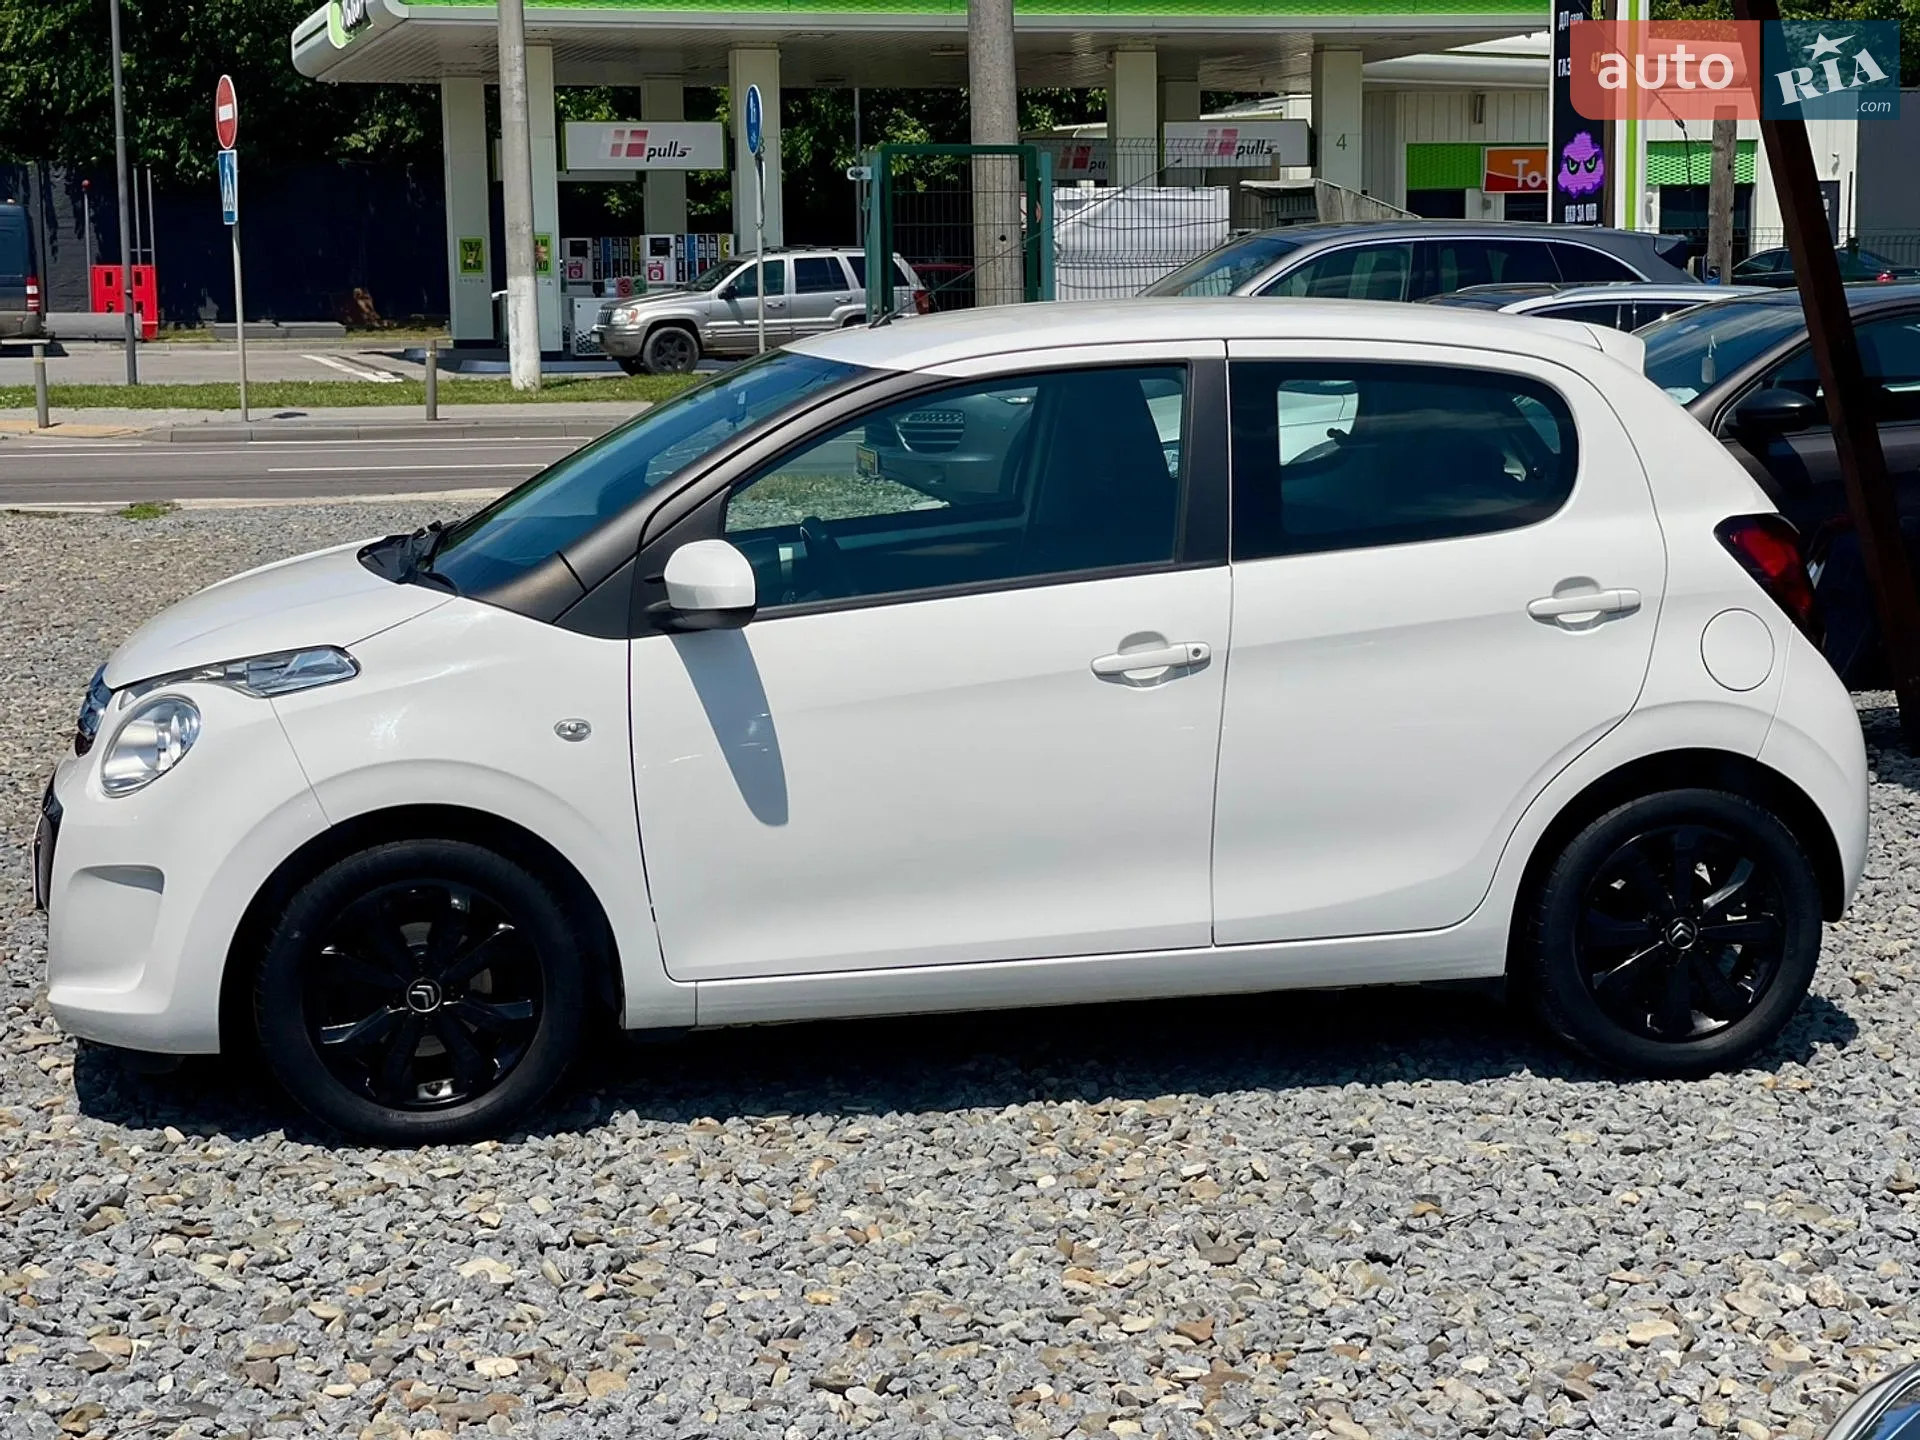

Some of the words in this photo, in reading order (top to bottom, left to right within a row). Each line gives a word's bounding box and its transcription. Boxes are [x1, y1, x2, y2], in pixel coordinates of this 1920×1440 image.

[646, 140, 692, 163] pulls
[1235, 138, 1278, 160] pulls
[1335, 133, 1348, 151] 4
[1088, 160, 1109, 173] pu
[1511, 158, 1549, 188] To
